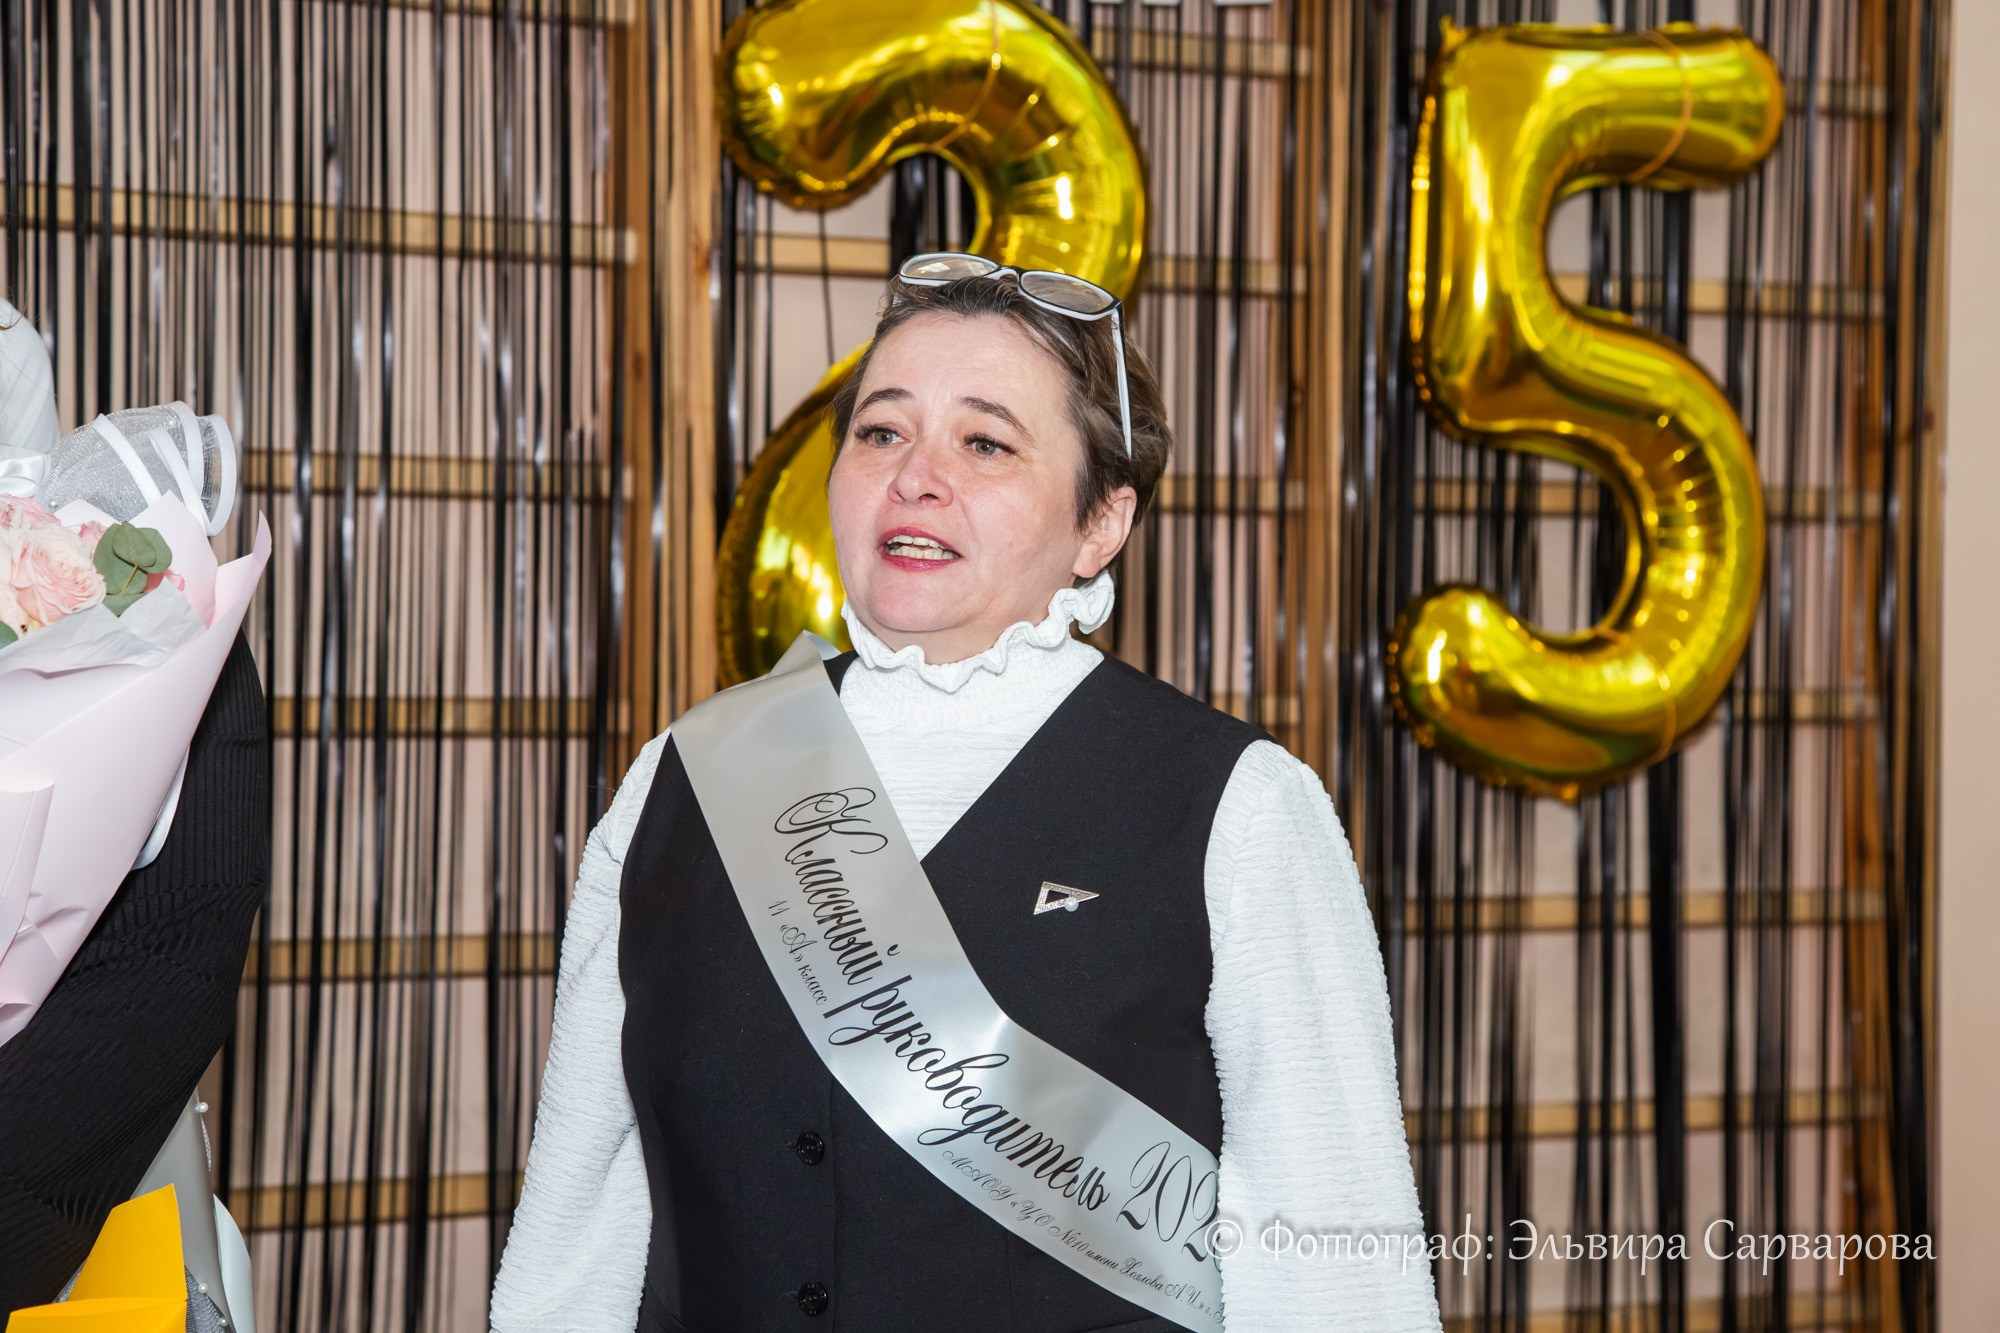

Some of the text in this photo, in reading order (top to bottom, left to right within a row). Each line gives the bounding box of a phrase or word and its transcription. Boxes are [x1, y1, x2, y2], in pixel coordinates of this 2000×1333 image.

[767, 899, 792, 917] 11
[797, 964, 828, 1006] класс
[774, 787, 1222, 1274] Классный руководитель 202
[1086, 1249, 1119, 1270] имени
